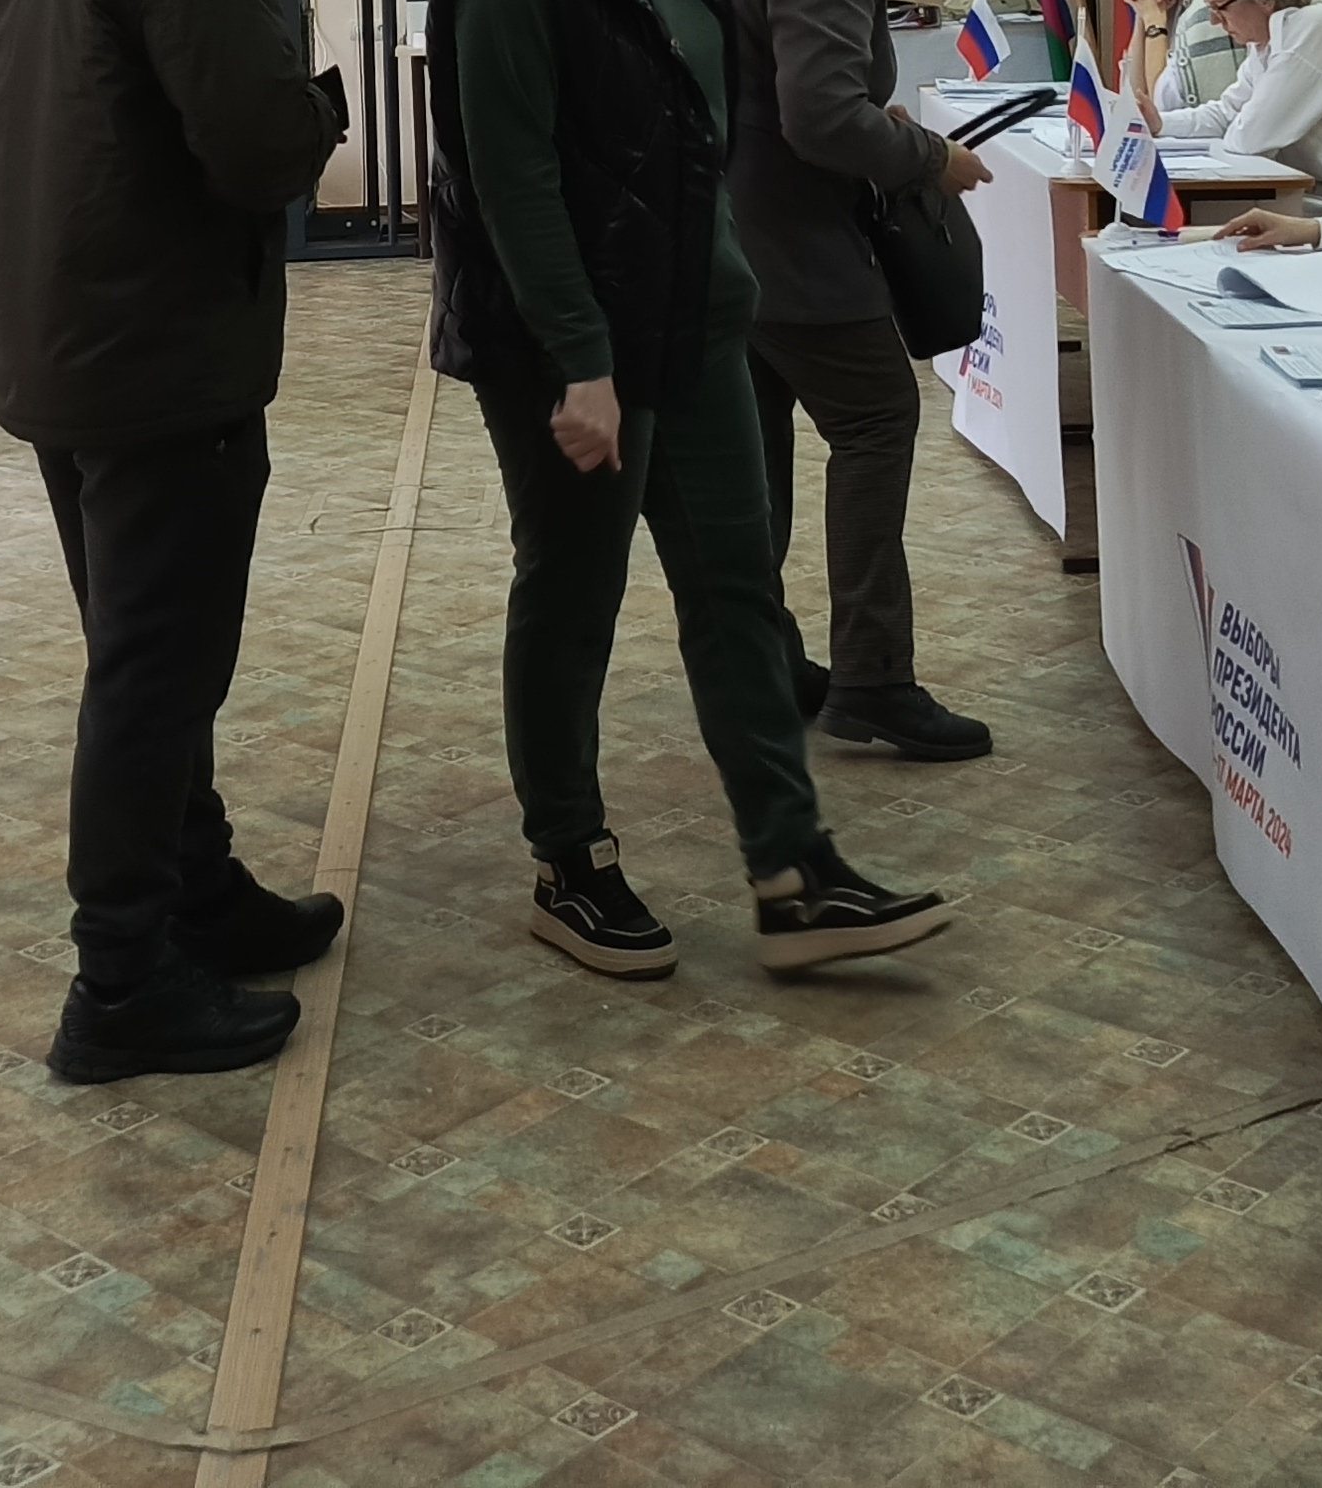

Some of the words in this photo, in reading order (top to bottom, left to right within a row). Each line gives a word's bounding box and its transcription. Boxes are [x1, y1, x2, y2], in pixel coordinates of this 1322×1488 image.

[1219, 601, 1281, 690] ВЫБОРЫ
[1213, 645, 1302, 771] ПРЕЗИДЕНТА
[1225, 764, 1265, 829] МАРТА
[1264, 807, 1292, 860] 2024
